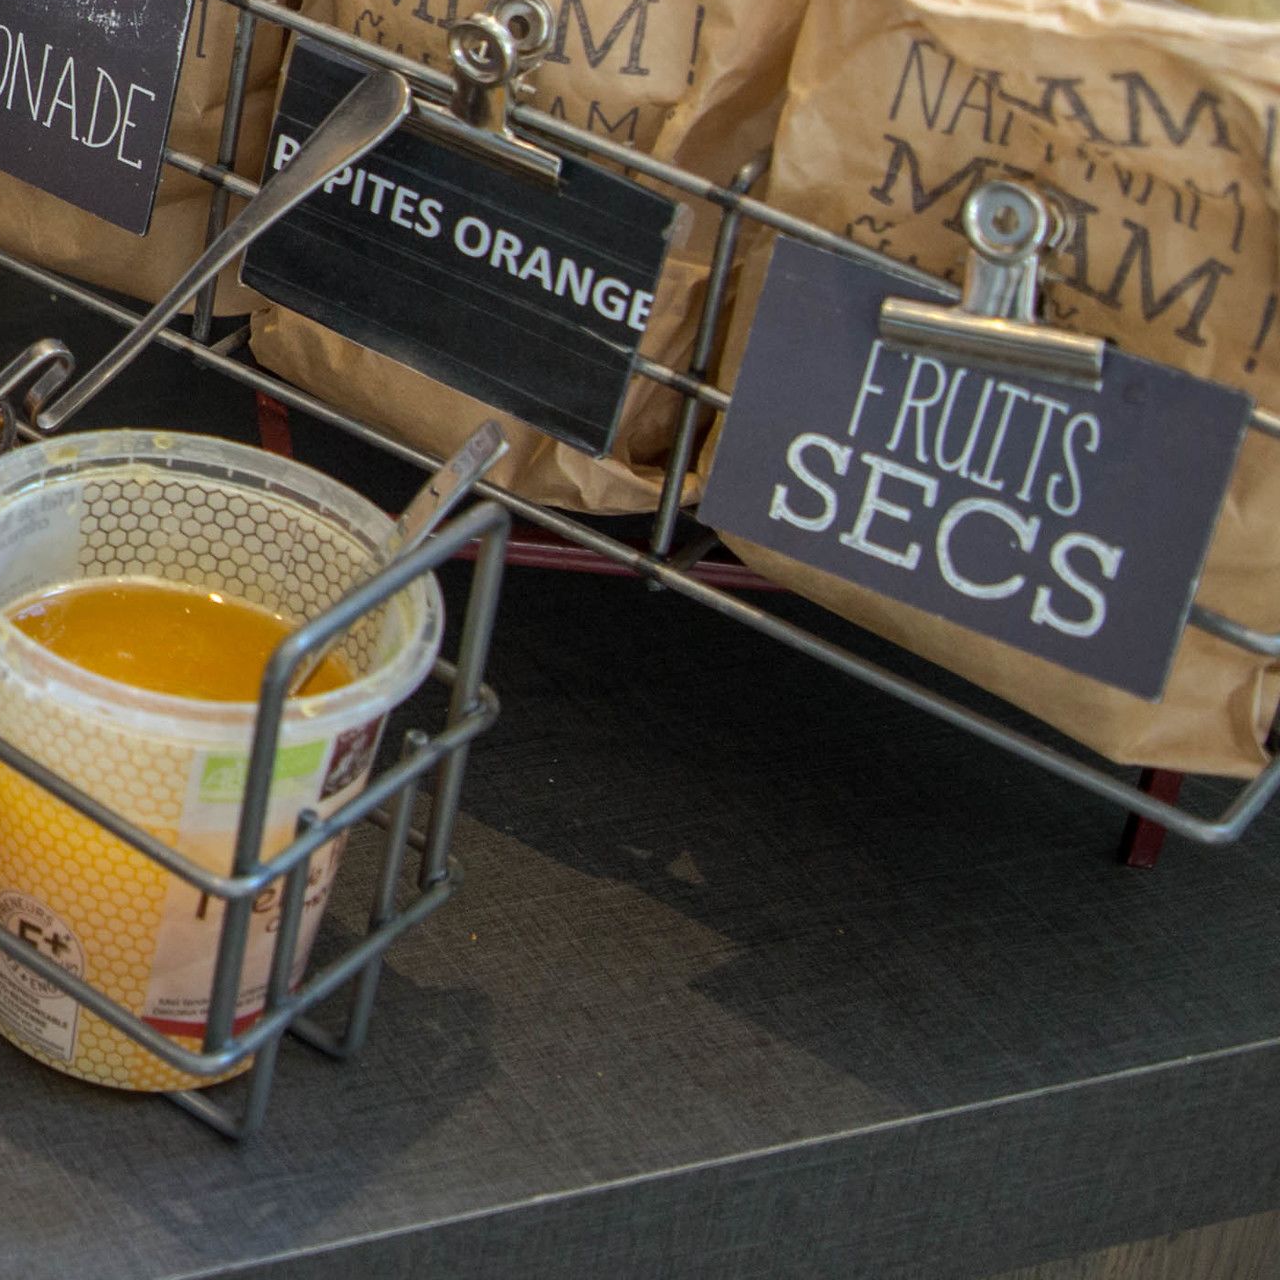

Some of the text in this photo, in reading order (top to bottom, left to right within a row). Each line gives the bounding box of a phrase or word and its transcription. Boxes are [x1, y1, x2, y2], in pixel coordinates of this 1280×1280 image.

[273, 133, 654, 332] PPITES ORANGE
[847, 339, 1101, 518] FRUITS
[769, 432, 1124, 639] SECS
